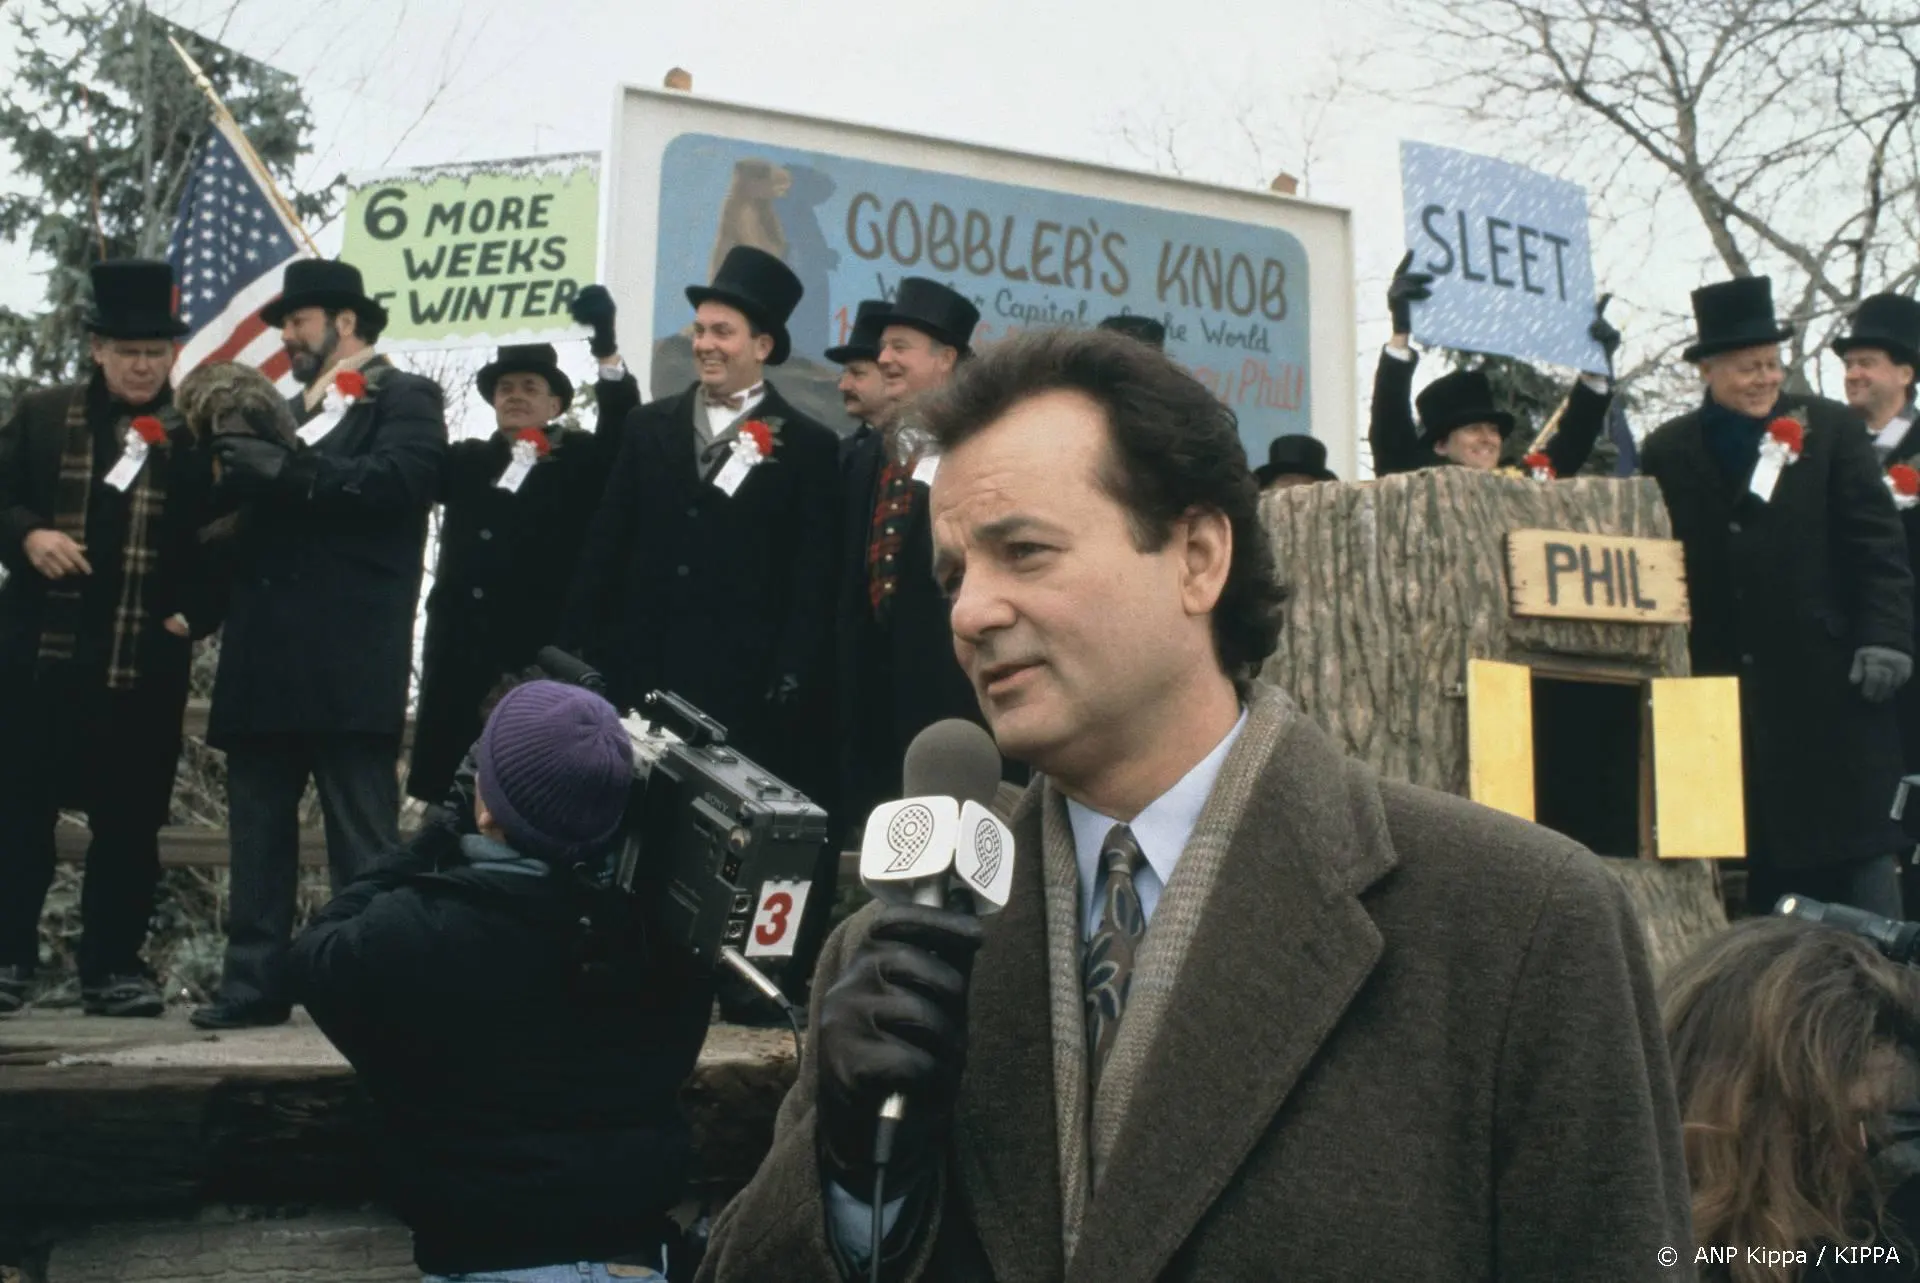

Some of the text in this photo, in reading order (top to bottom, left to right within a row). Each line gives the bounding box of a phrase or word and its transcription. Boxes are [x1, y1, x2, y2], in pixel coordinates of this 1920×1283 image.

[364, 188, 554, 240] 6 MORE
[403, 236, 568, 281] WEEKS
[847, 192, 1287, 321] GOBBLER'S KNOB
[1422, 204, 1570, 301] SLEET
[408, 278, 579, 325] WINTER
[995, 288, 1093, 328] Capital
[1164, 312, 1187, 342] he
[1201, 317, 1271, 353] World
[1544, 542, 1657, 610] PHIL
[883, 803, 935, 874] 9
[971, 817, 1003, 889] 9
[755, 892, 793, 946] 3
